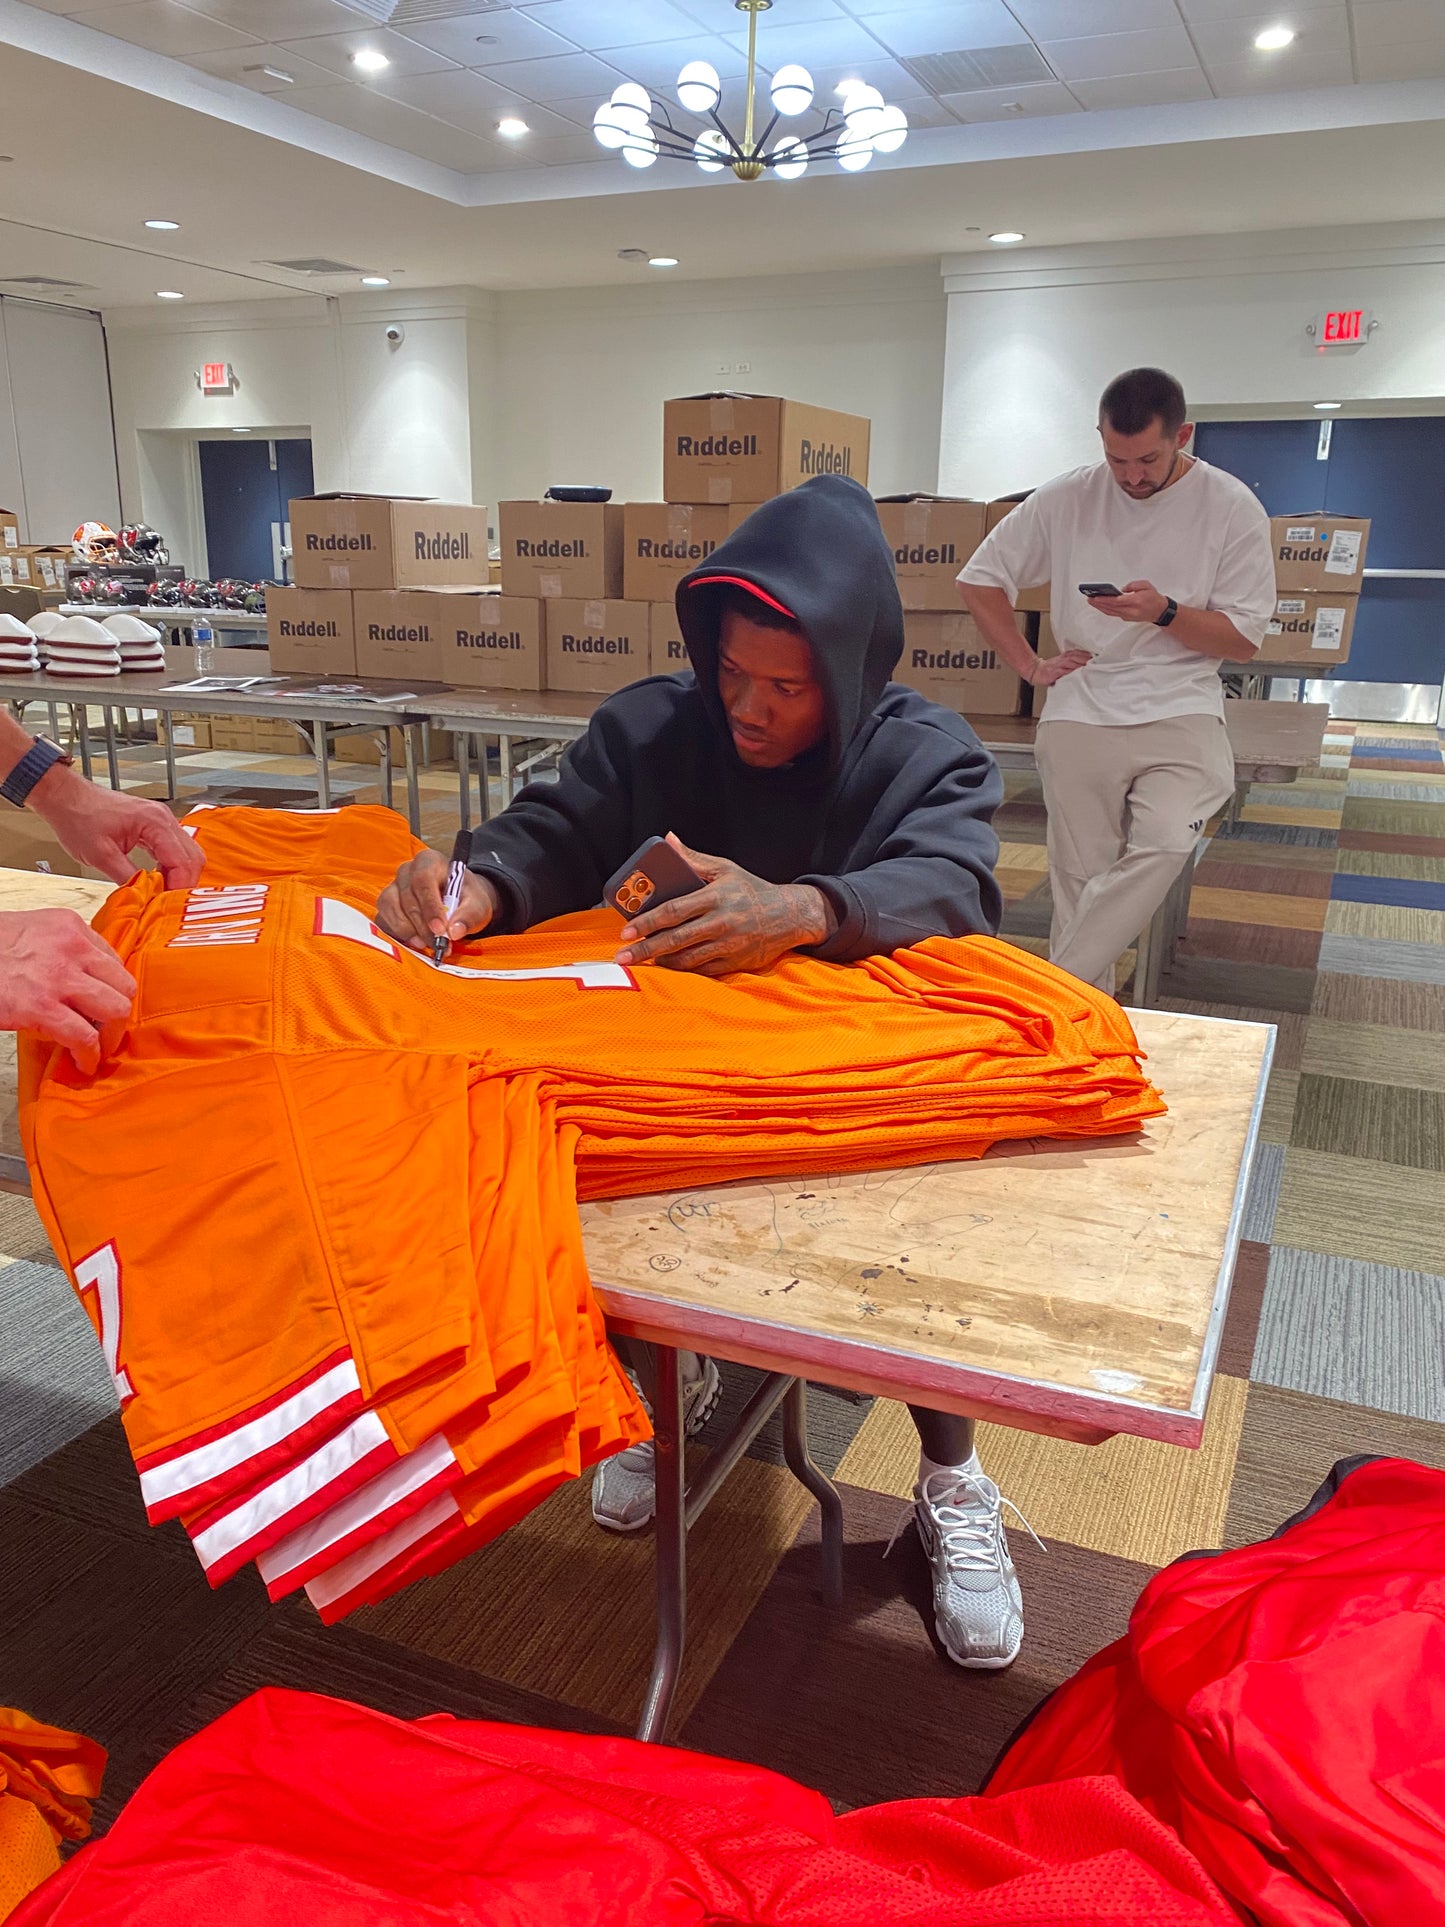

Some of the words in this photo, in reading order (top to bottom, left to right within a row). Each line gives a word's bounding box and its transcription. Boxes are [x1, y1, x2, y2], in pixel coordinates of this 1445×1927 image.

[1323, 310, 1363, 342] EXIT
[204, 363, 225, 385] EXIT
[677, 435, 757, 456] Riddell
[800, 439, 850, 476] Riddell
[306, 533, 372, 551] Riddell
[414, 531, 469, 560] Riddell
[516, 539, 585, 558] Riddell
[895, 544, 955, 564] ddell
[279, 620, 337, 638] Riddell
[368, 624, 430, 643] Riddell
[456, 630, 521, 650] Riddell
[562, 634, 630, 655] Riddell
[911, 649, 996, 669] Riddell
[165, 884, 270, 948] IRVING
